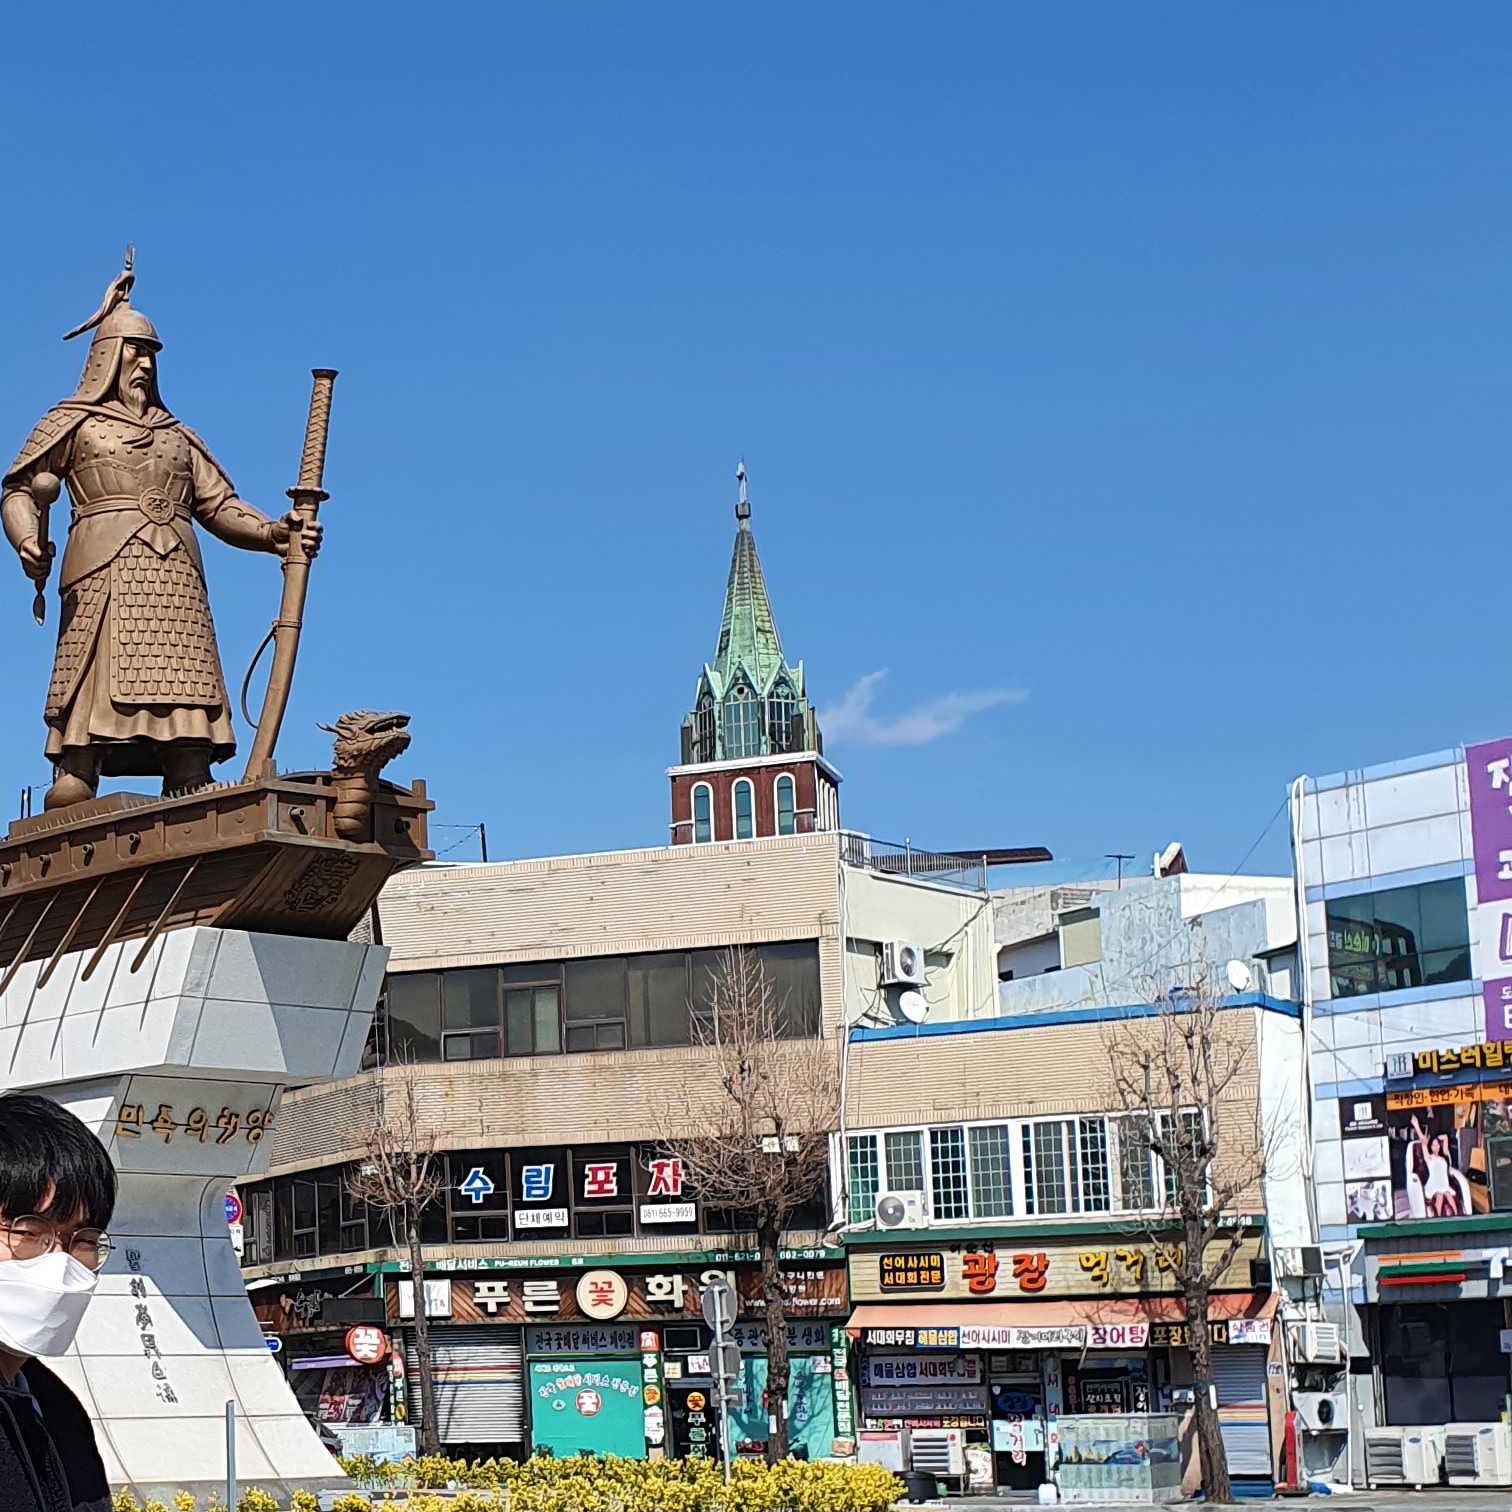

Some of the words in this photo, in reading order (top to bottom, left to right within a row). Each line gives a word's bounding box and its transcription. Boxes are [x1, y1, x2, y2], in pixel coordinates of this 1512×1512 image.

[518, 1210, 565, 1226] 단체예약
[883, 1255, 941, 1269] 선어사시미
[962, 1252, 1051, 1294] 광장
[883, 1271, 918, 1285] 서대회
[919, 1270, 942, 1284] 전문
[473, 1280, 561, 1314] 푸른
[588, 1281, 616, 1308] 꽃
[353, 1328, 381, 1358] 꽃
[535, 1333, 553, 1350] 전국
[801, 1326, 826, 1346] 생화
[866, 1329, 916, 1345] 서대회무침
[918, 1329, 958, 1345] 해물삼합
[961, 1328, 1011, 1344] 선어사시미
[1091, 1325, 1148, 1345] 장어탕
[1153, 1325, 1228, 1347] 포장다
[874, 1361, 917, 1379] 해물삼합
[1135, 1387, 1148, 1413] 장어
